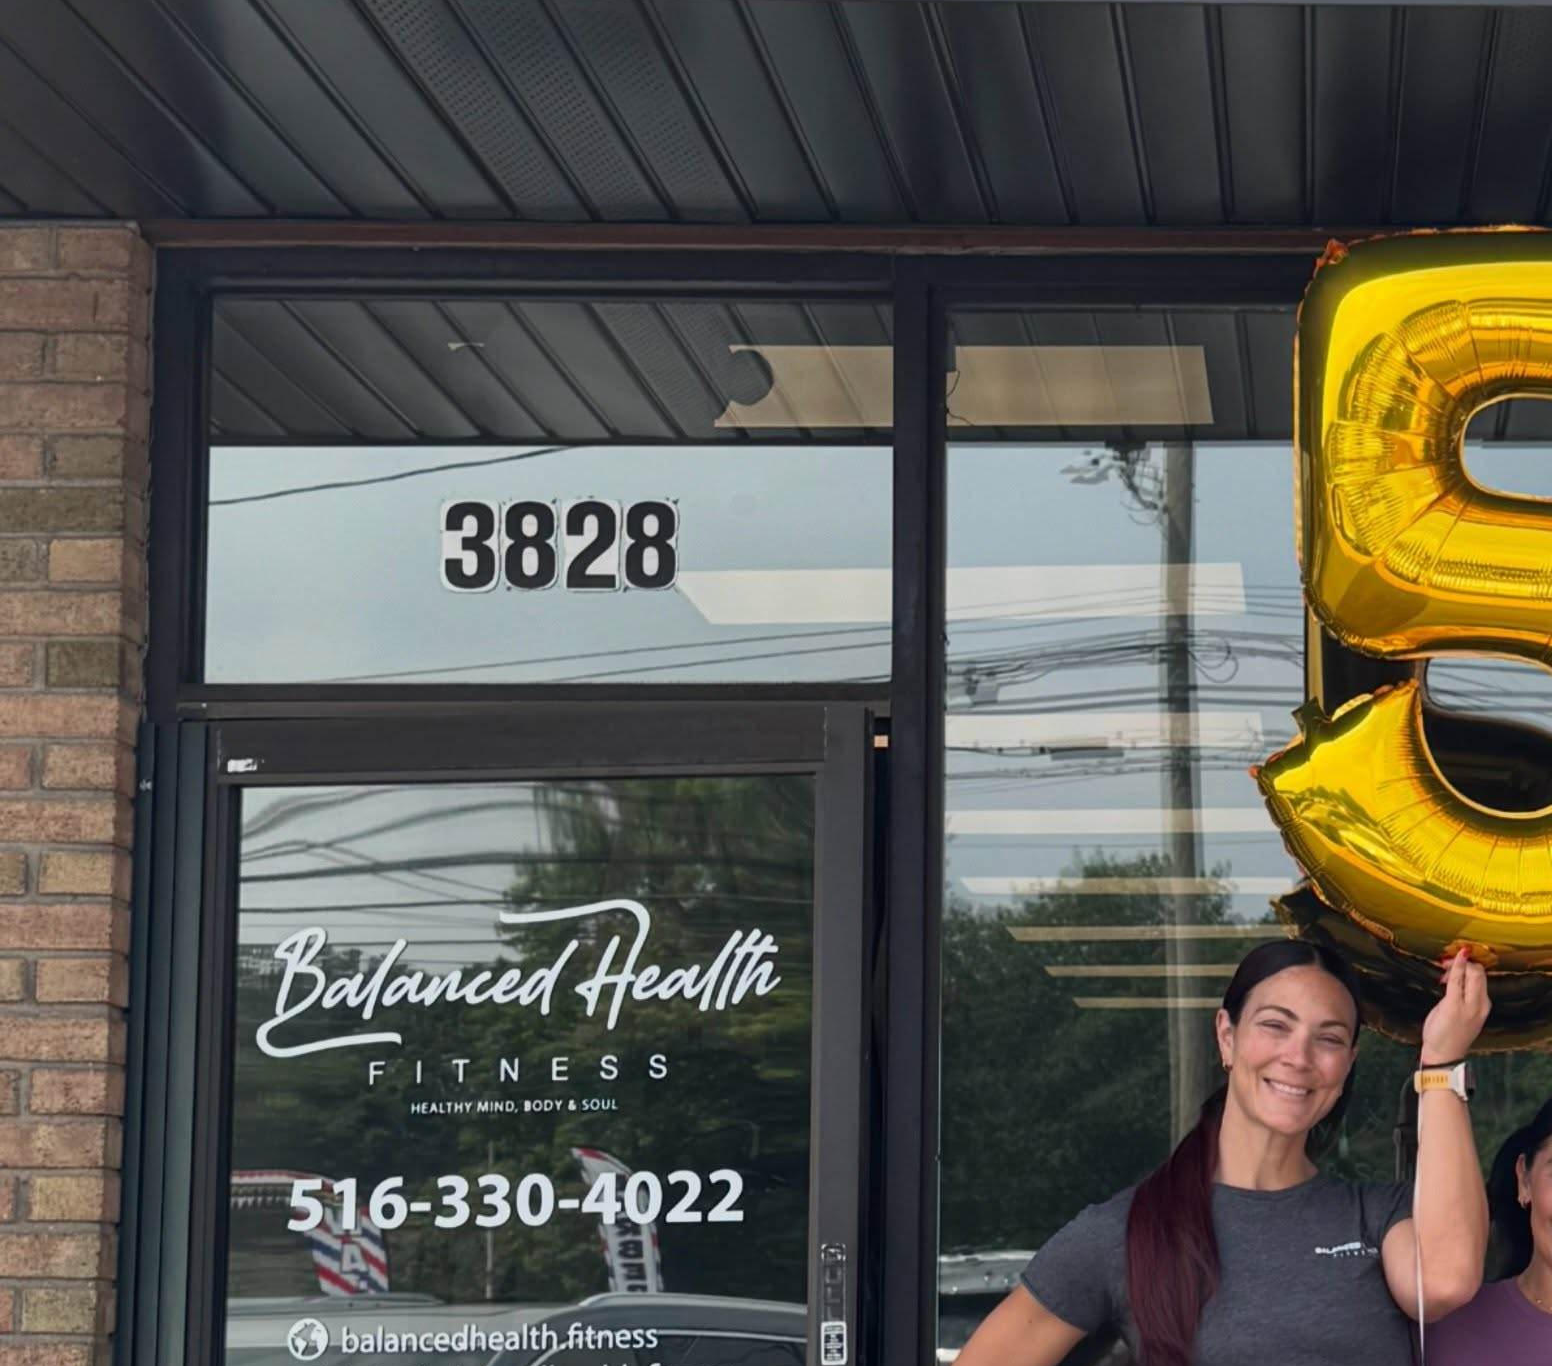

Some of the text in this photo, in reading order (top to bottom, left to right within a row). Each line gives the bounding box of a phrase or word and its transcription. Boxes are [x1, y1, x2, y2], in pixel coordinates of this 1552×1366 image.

[445, 501, 676, 590] 3828
[256, 899, 781, 1057] Balanced Health
[368, 1054, 668, 1085] FITNESS
[411, 1098, 618, 1114] HEALTHY MIND, BODY & SOUL
[287, 1169, 744, 1232] 516-330-4022
[341, 1322, 658, 1355] balancedhealth.fitness
